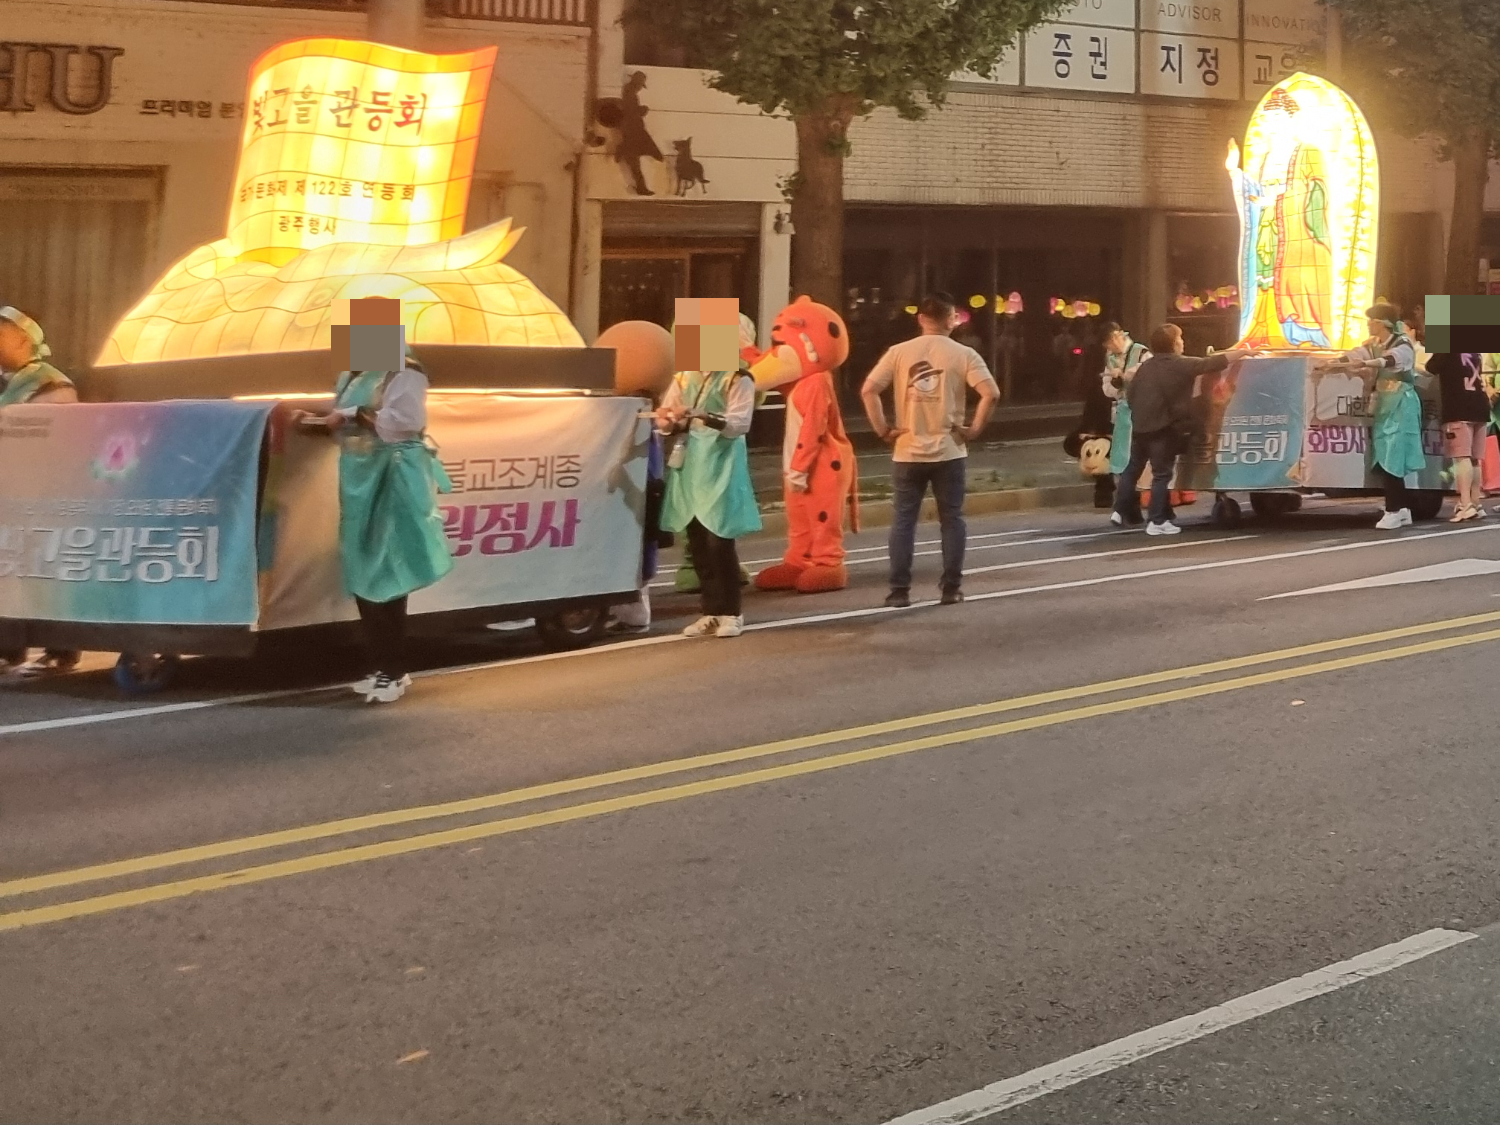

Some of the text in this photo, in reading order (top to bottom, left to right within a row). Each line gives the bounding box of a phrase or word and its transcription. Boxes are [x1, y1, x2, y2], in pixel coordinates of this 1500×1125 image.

[1157, 2, 1222, 23] ADVISOR
[1052, 33, 1108, 80] 증권
[1160, 43, 1220, 87] 지정
[140, 99, 212, 119] 프리미엄
[253, 84, 428, 136] 빛고을 관등회
